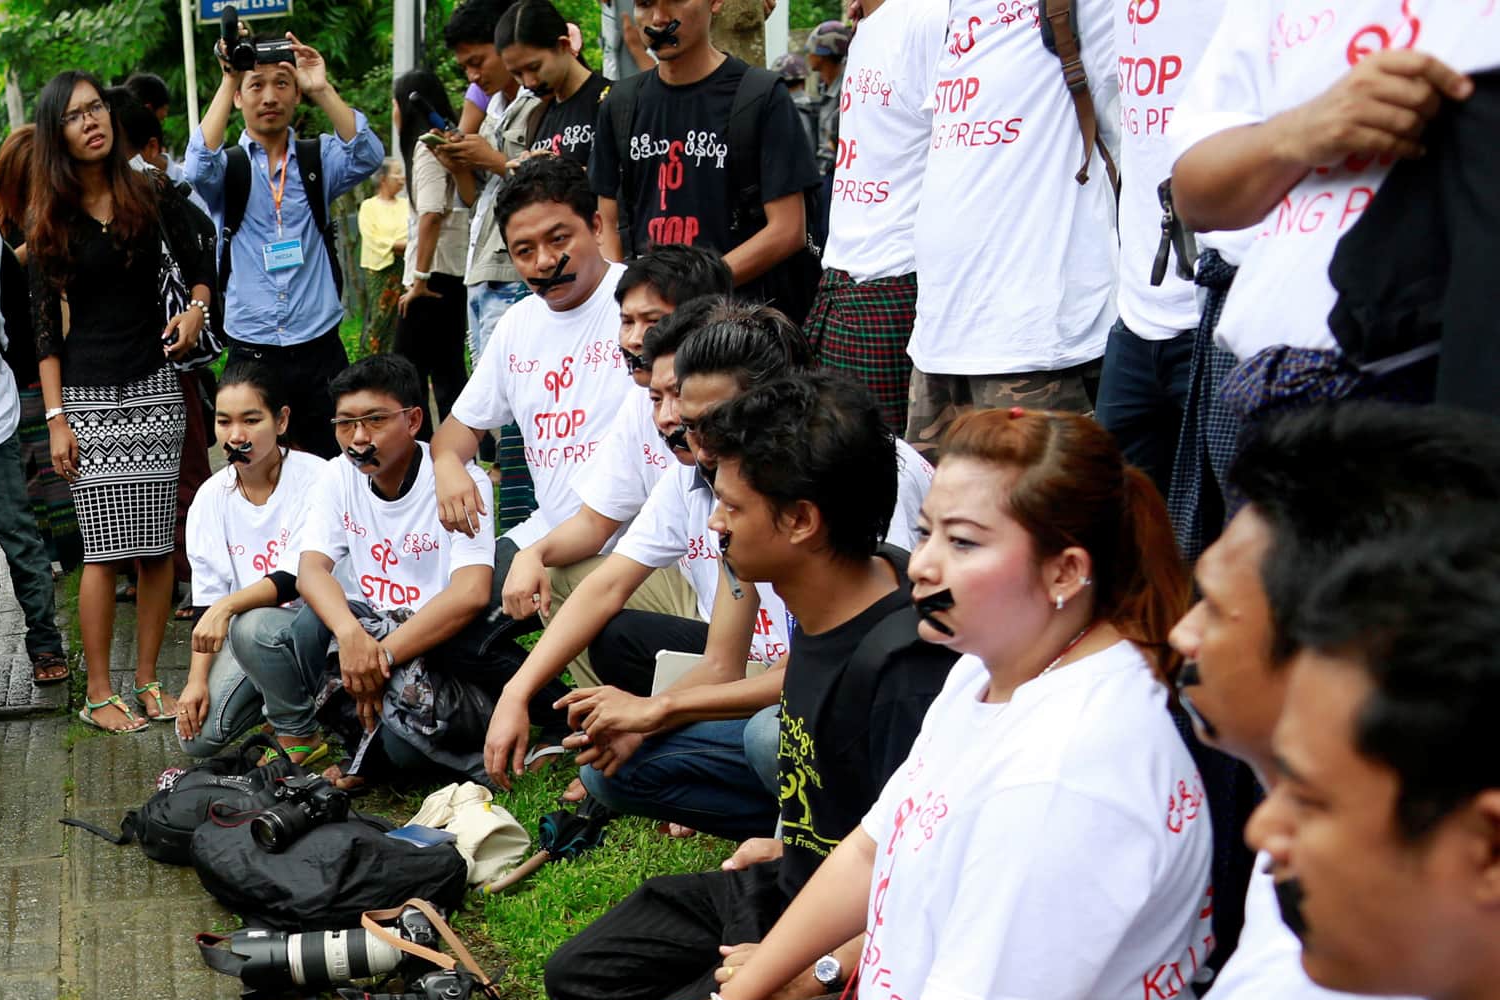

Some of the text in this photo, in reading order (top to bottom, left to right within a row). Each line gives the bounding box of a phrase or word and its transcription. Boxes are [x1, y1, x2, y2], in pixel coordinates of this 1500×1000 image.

[933, 76, 980, 115] STOP
[946, 117, 1023, 149] PRESS
[658, 140, 684, 211] ရပ်
[544, 356, 574, 403] ရပ်
[534, 408, 586, 441] STOP
[360, 574, 421, 606] STOP
